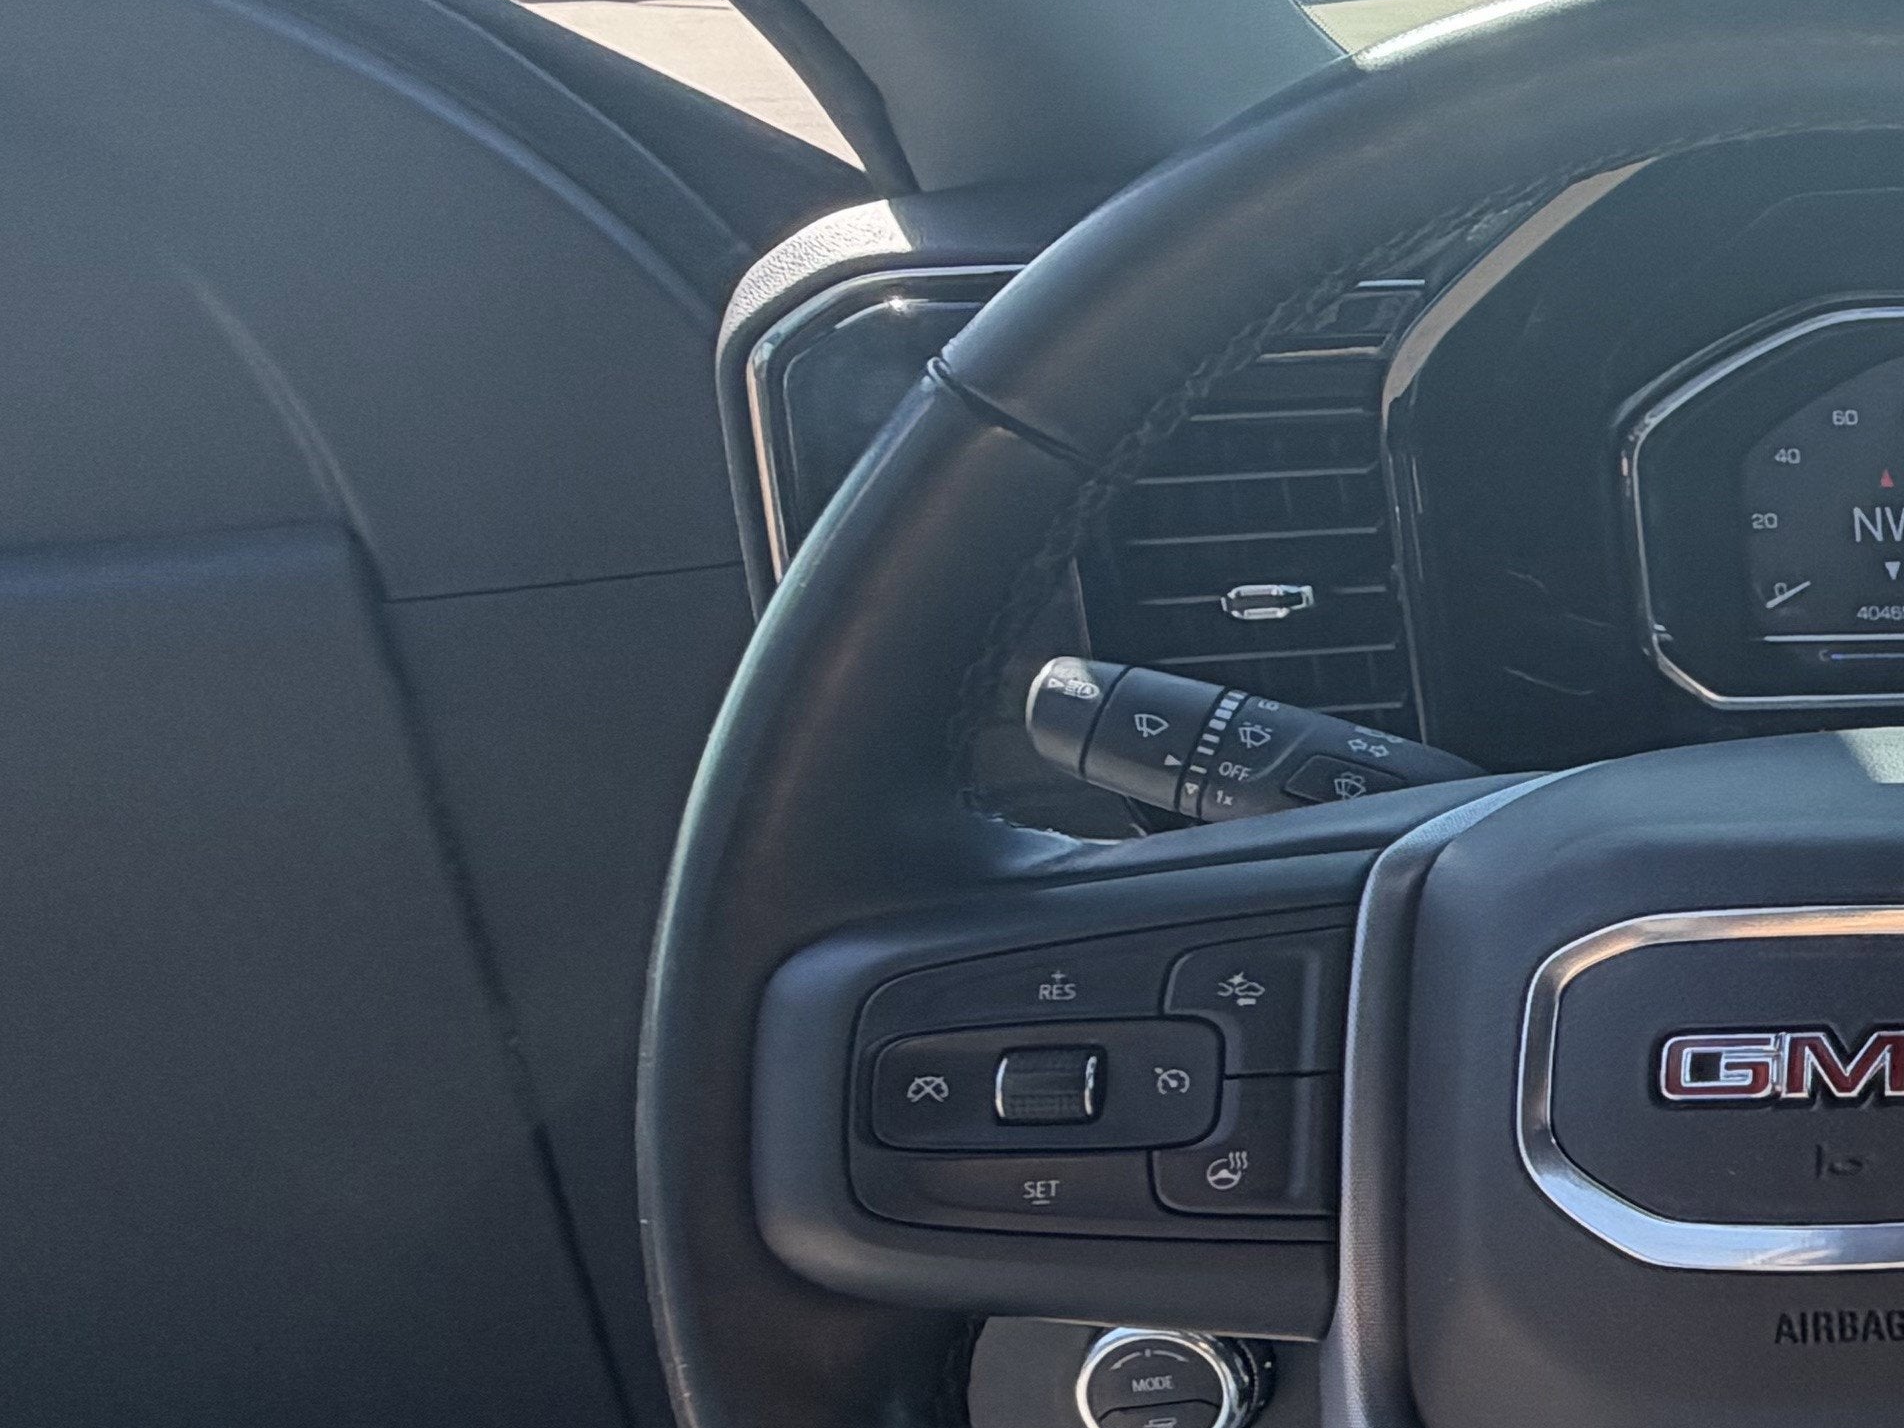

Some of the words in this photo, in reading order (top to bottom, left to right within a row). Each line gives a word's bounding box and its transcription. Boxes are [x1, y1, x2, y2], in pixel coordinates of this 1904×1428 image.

[1831, 408, 1860, 426] 60
[1774, 447, 1801, 465] 40
[1750, 512, 1778, 530] 20
[1218, 761, 1251, 781] OFF
[1039, 982, 1078, 1001] RES
[1022, 1179, 1060, 1197] SET
[1130, 1374, 1175, 1393] MODE
